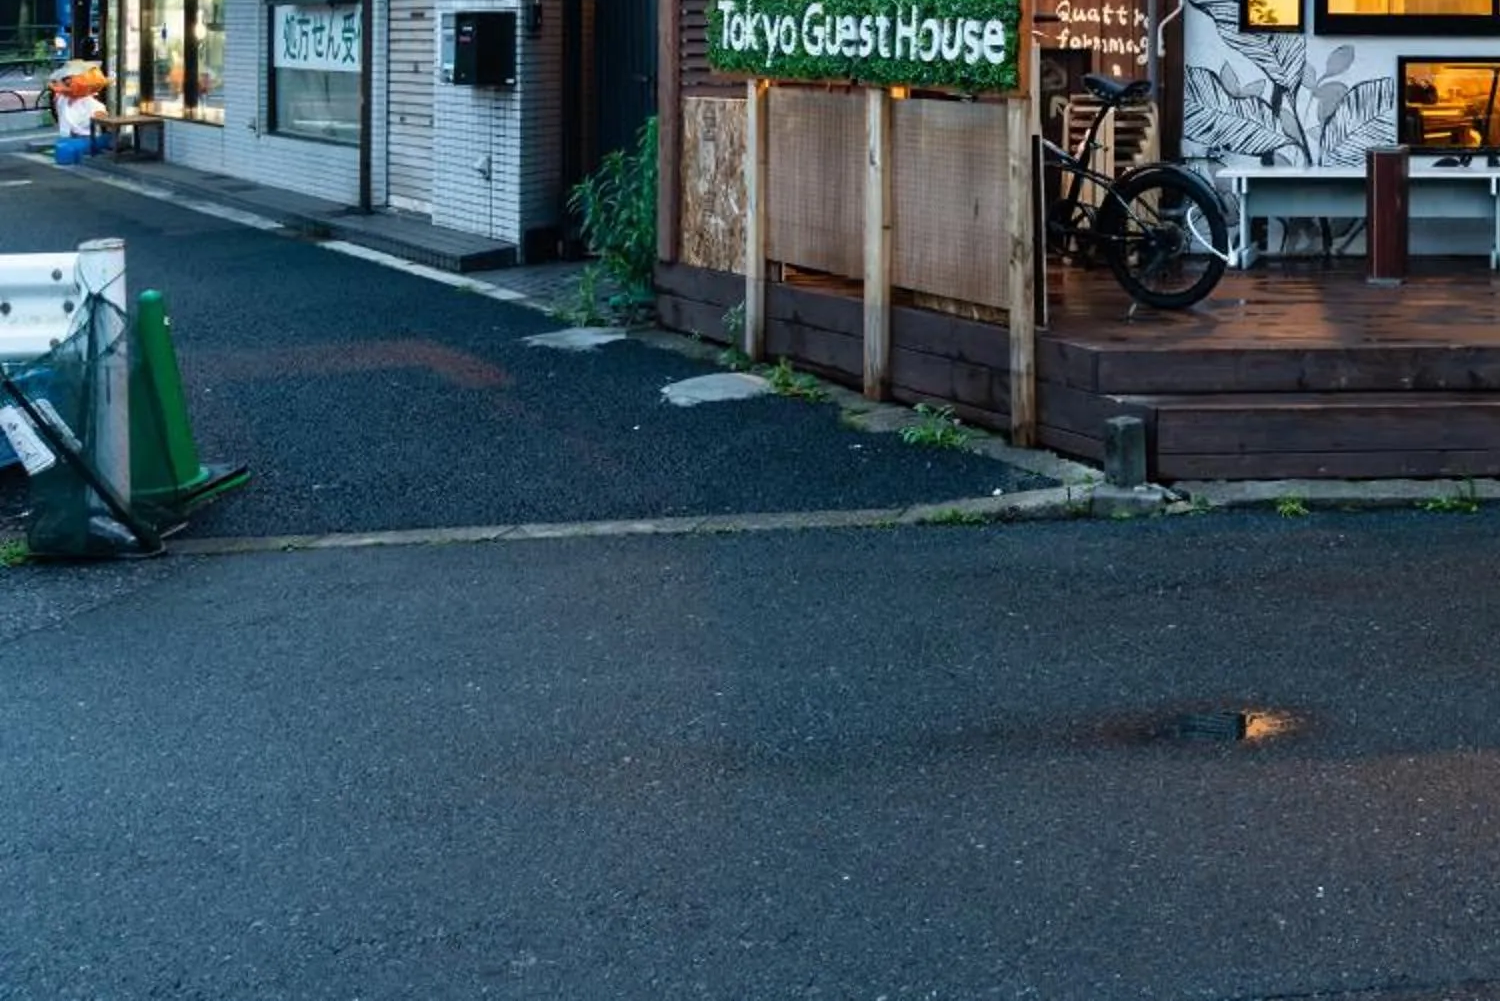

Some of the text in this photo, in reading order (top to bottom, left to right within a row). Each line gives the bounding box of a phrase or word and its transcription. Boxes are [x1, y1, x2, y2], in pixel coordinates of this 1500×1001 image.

[282, 12, 361, 64] 処方せん受
[802, 2, 892, 58] Guest
[895, 3, 1006, 65] House
